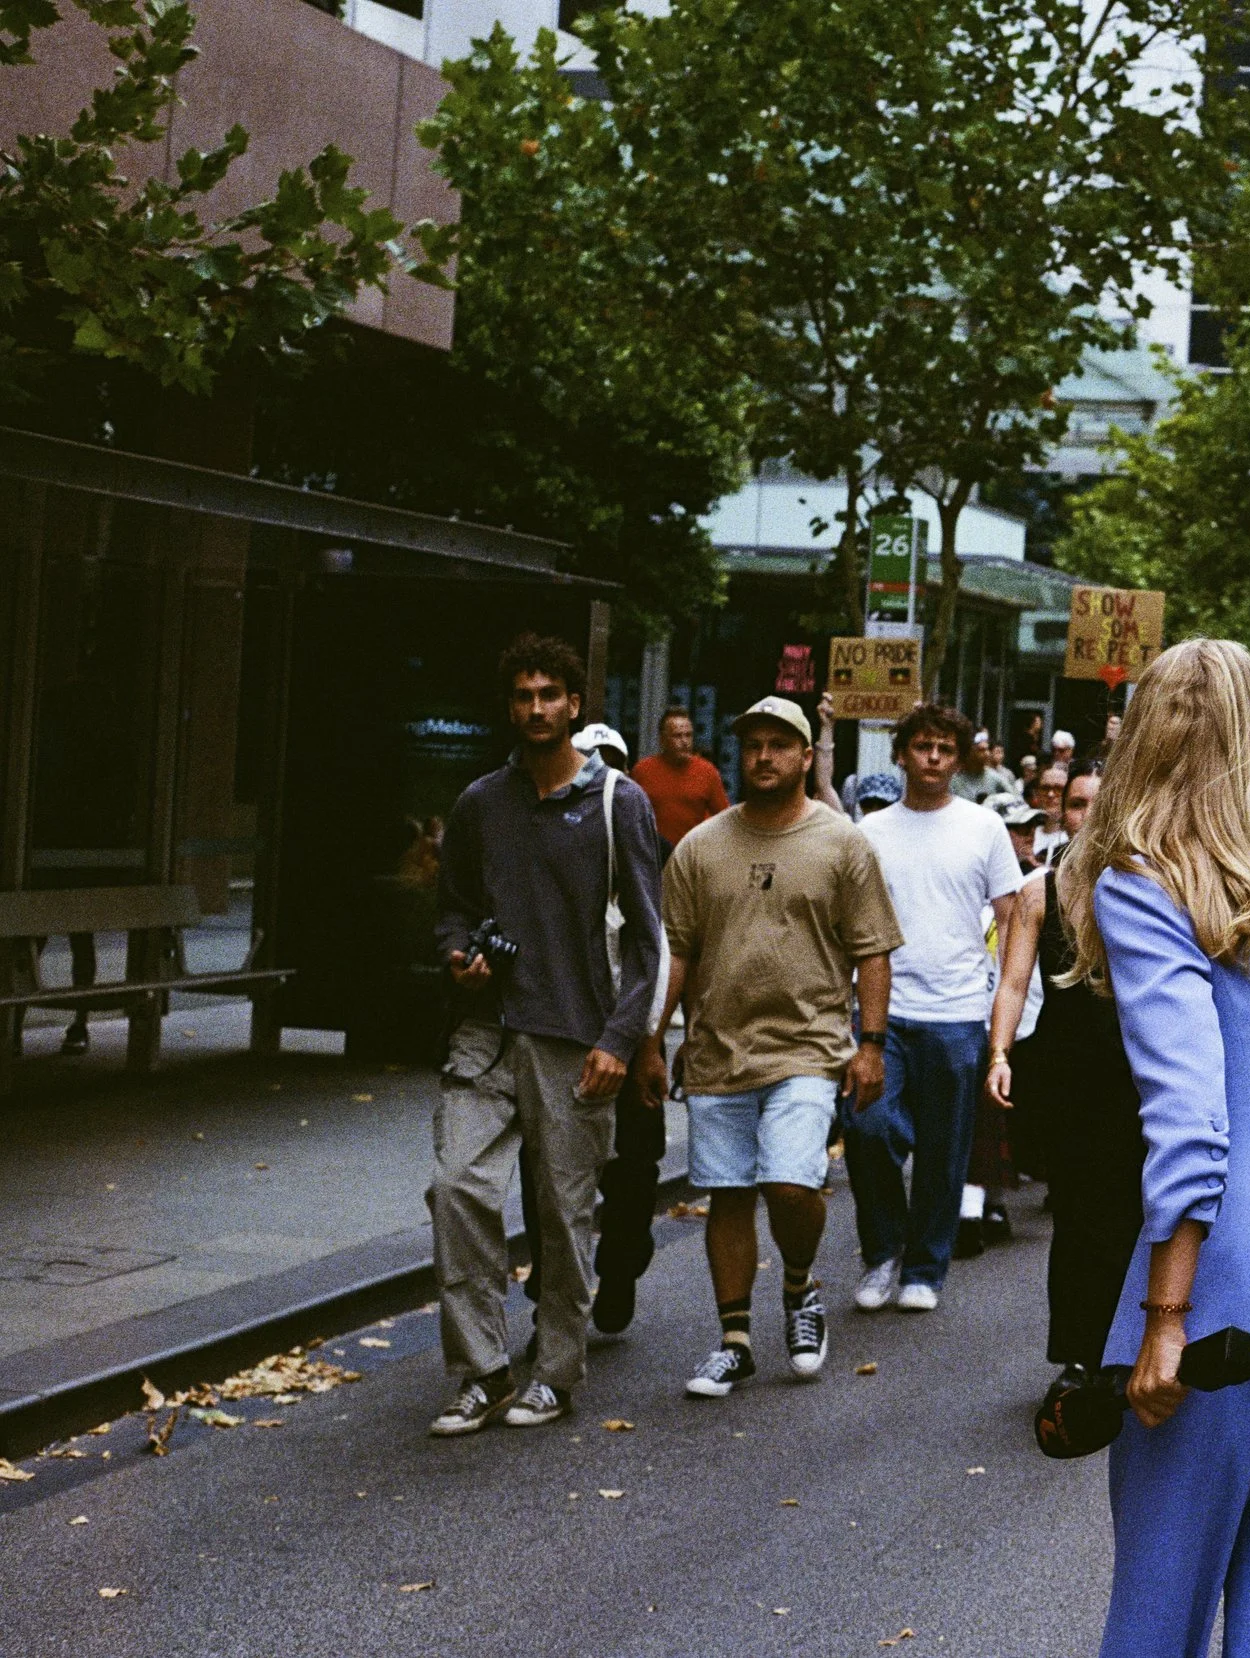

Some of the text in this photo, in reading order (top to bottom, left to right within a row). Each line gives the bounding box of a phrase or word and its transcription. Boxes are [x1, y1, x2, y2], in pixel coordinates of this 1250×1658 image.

[875, 533, 910, 557] 26
[1077, 590, 1136, 616] SHOW
[1100, 616, 1148, 645] SOME
[834, 643, 867, 665] NO
[873, 642, 918, 664] PRIDE
[1074, 637, 1155, 665] RESPECT
